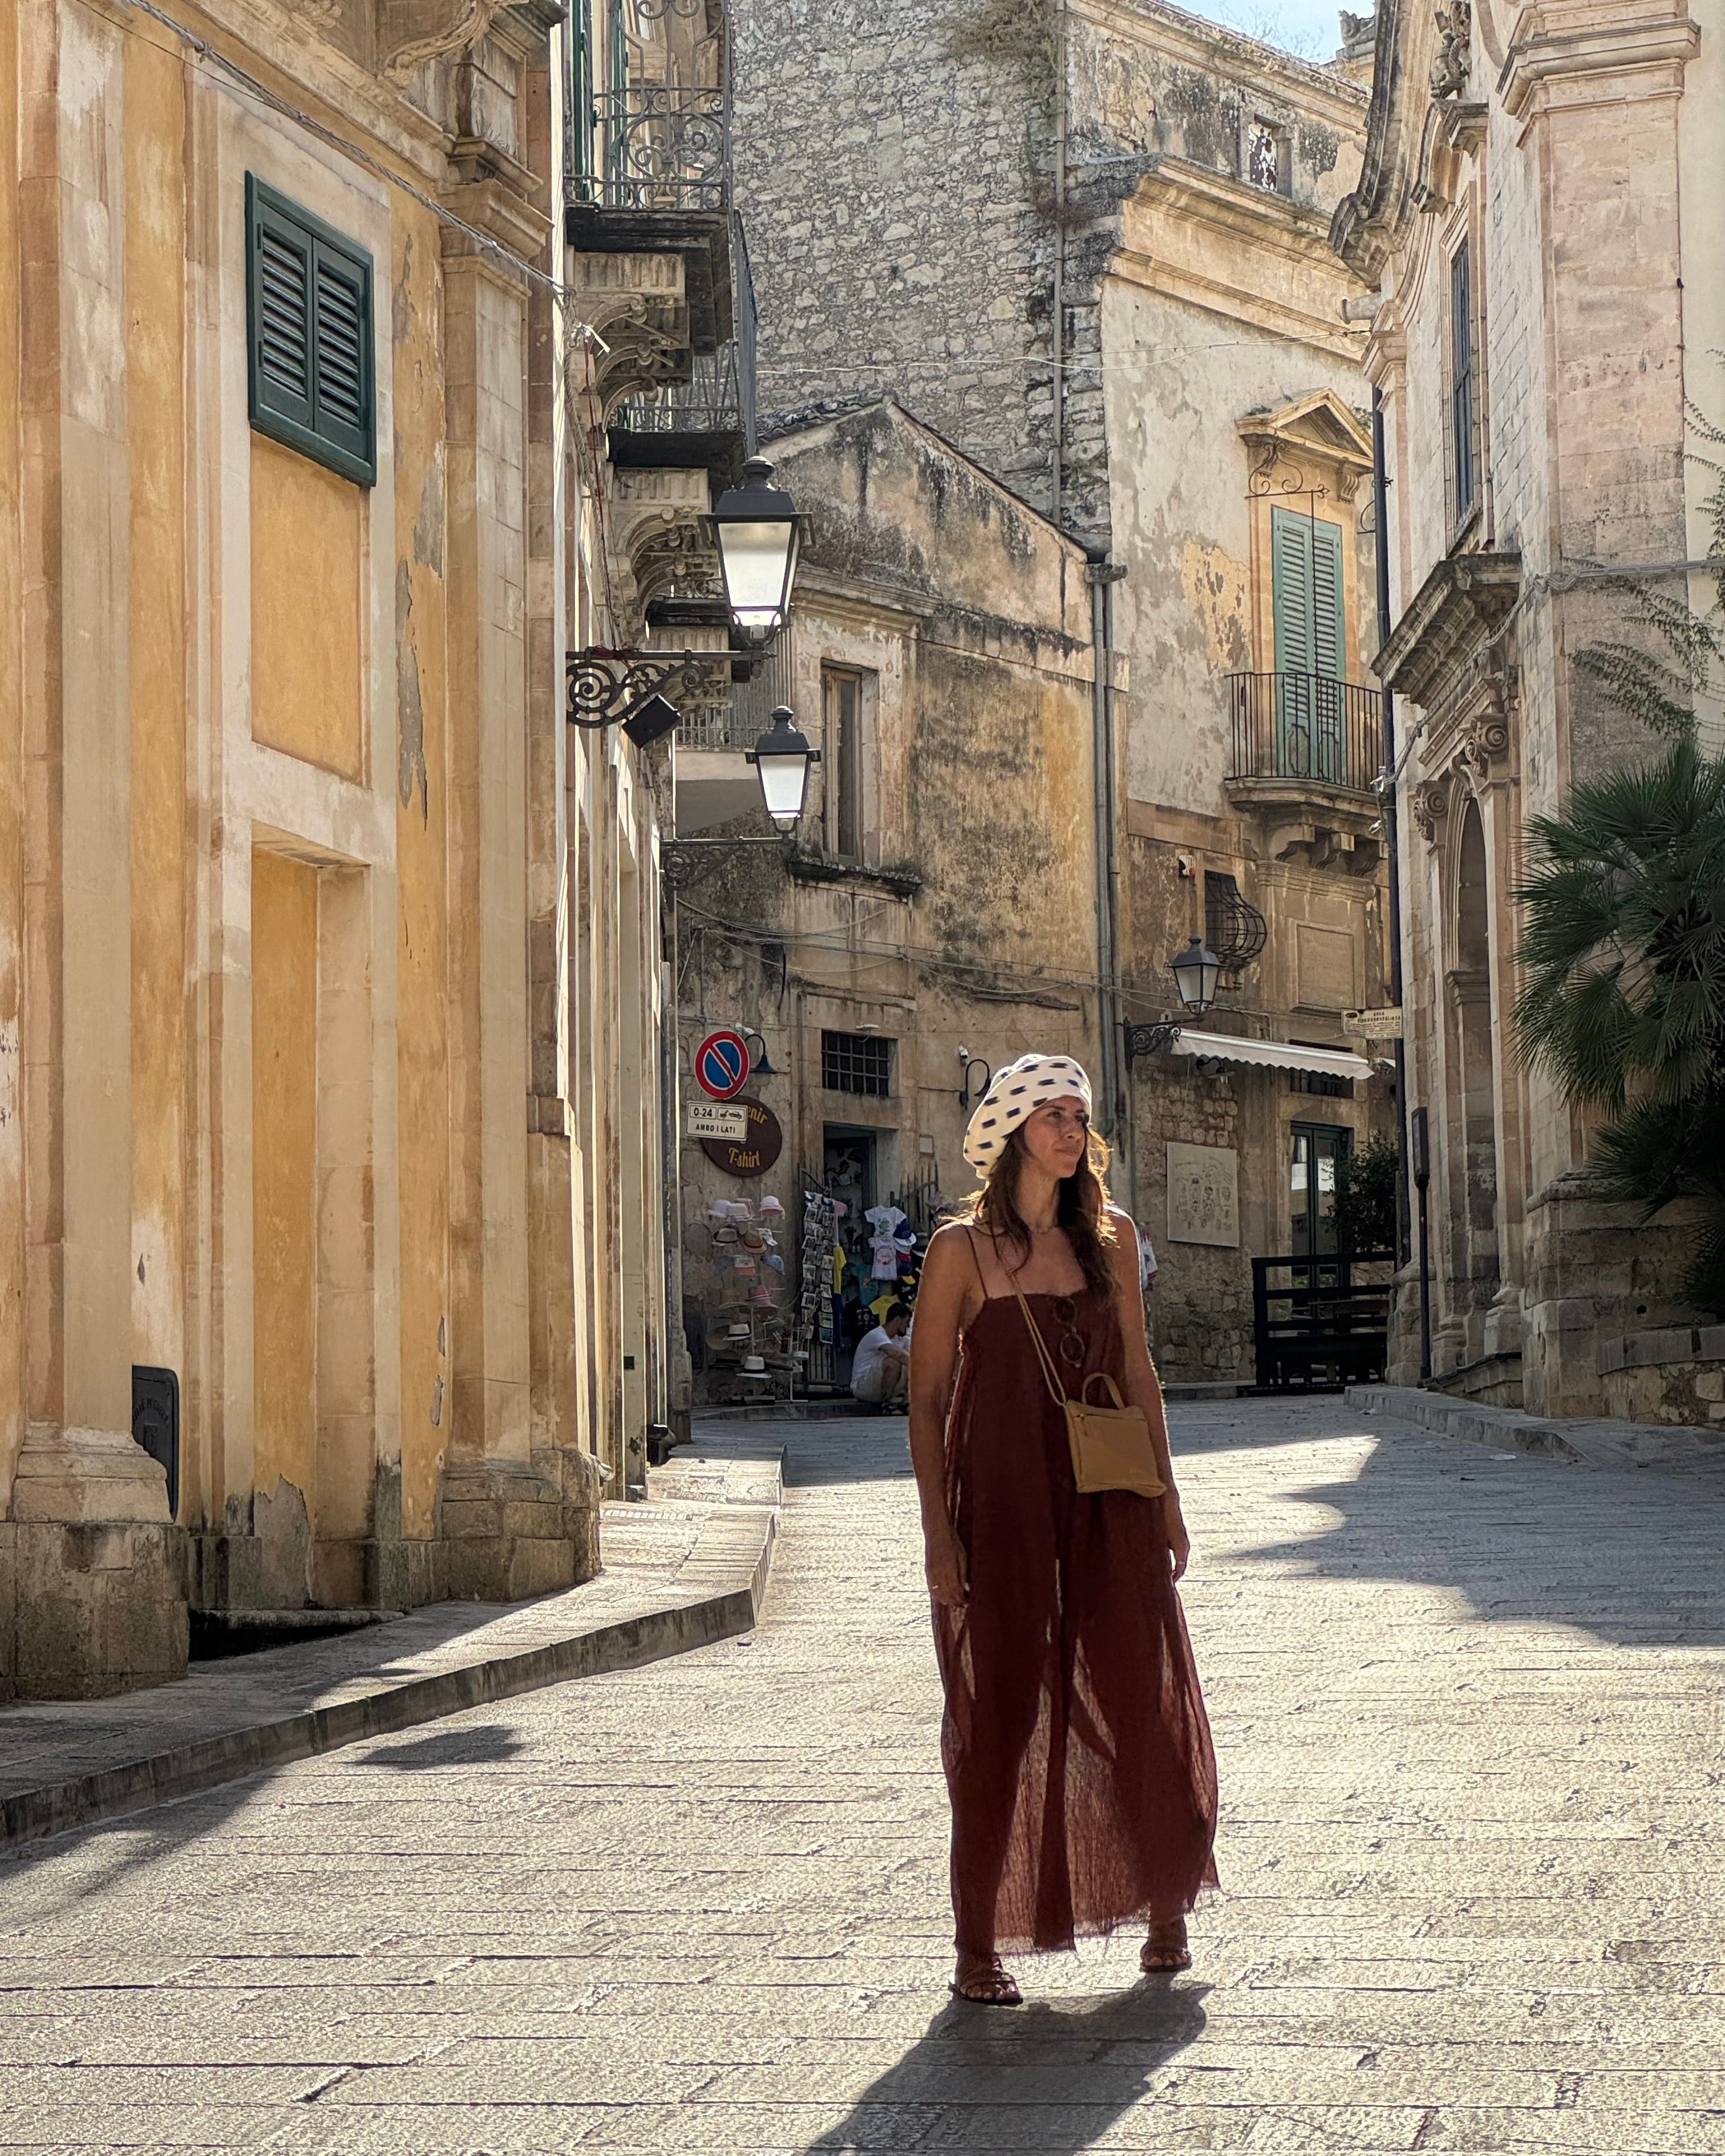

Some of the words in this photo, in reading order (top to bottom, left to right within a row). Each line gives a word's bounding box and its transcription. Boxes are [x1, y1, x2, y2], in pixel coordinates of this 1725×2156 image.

[694, 1107, 712, 1117] 0-24
[748, 1106, 767, 1124] enir
[695, 1124, 715, 1132] AMBO
[728, 1147, 760, 1168] T-shirt
